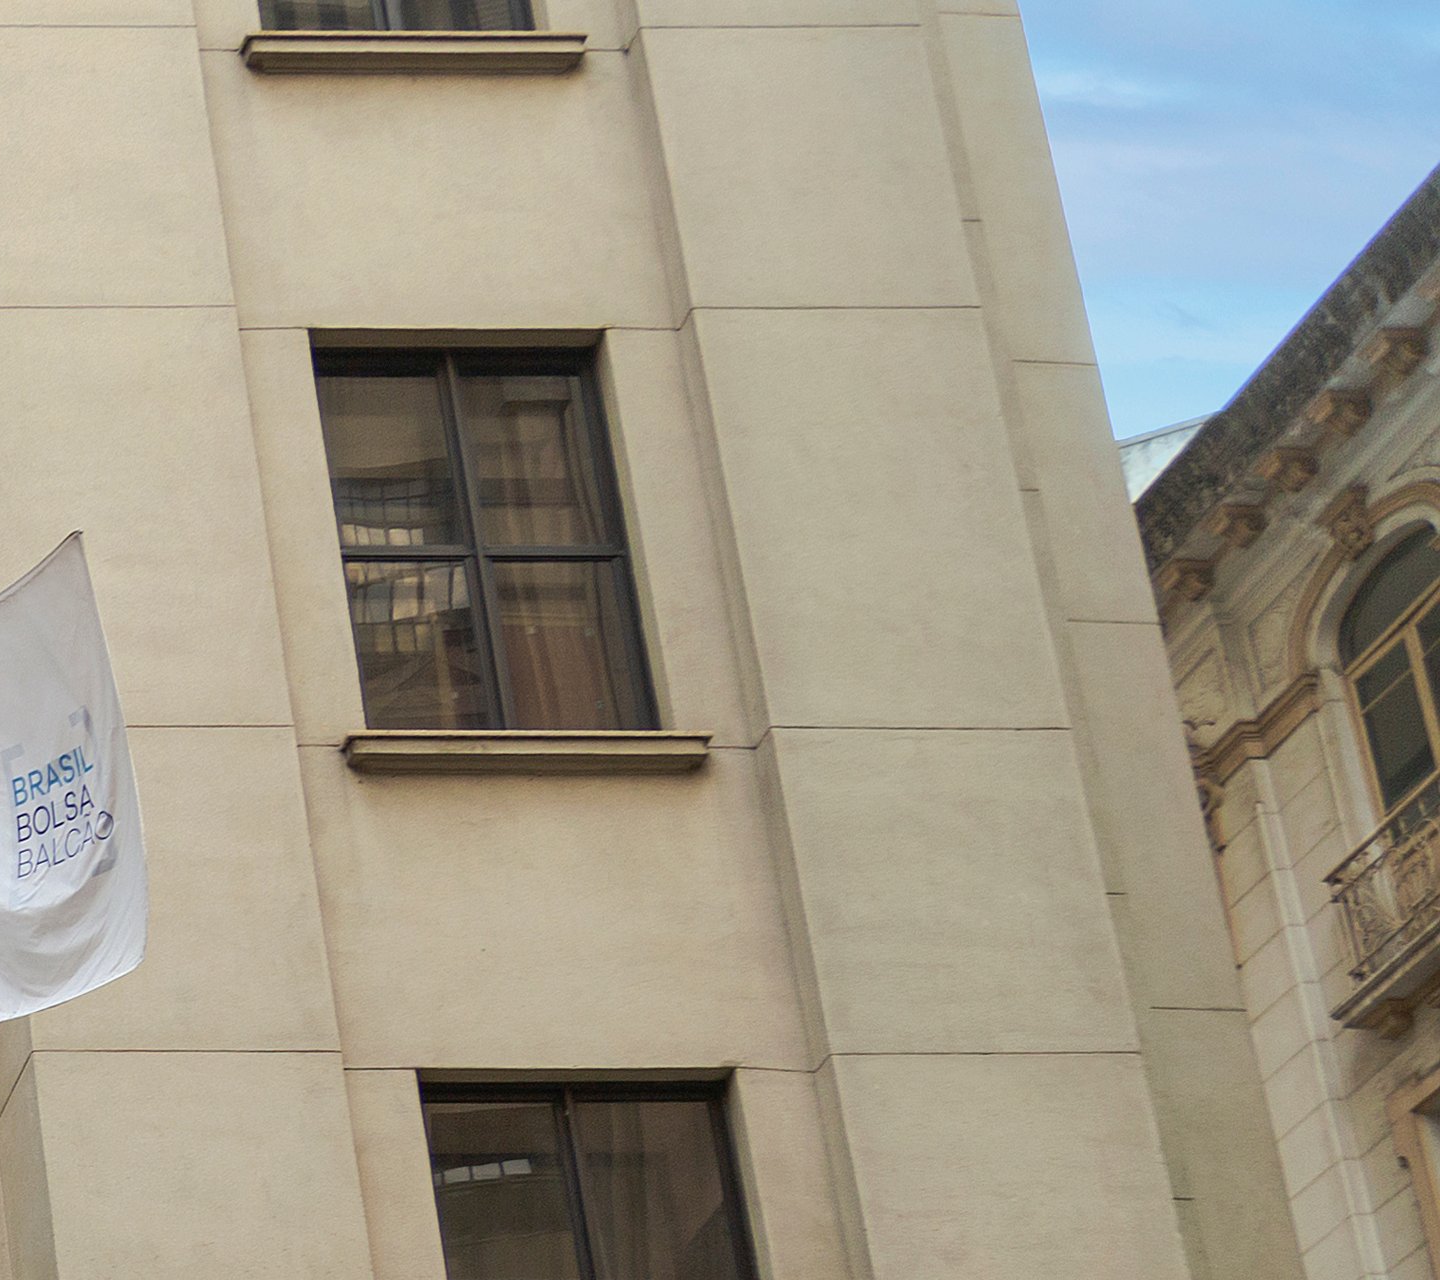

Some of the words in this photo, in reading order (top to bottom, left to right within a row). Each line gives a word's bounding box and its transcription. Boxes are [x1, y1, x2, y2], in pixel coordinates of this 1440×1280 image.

[12, 746, 94, 806] BRASIL
[16, 784, 95, 842] BOLSA
[17, 811, 114, 878] BALCÃO
